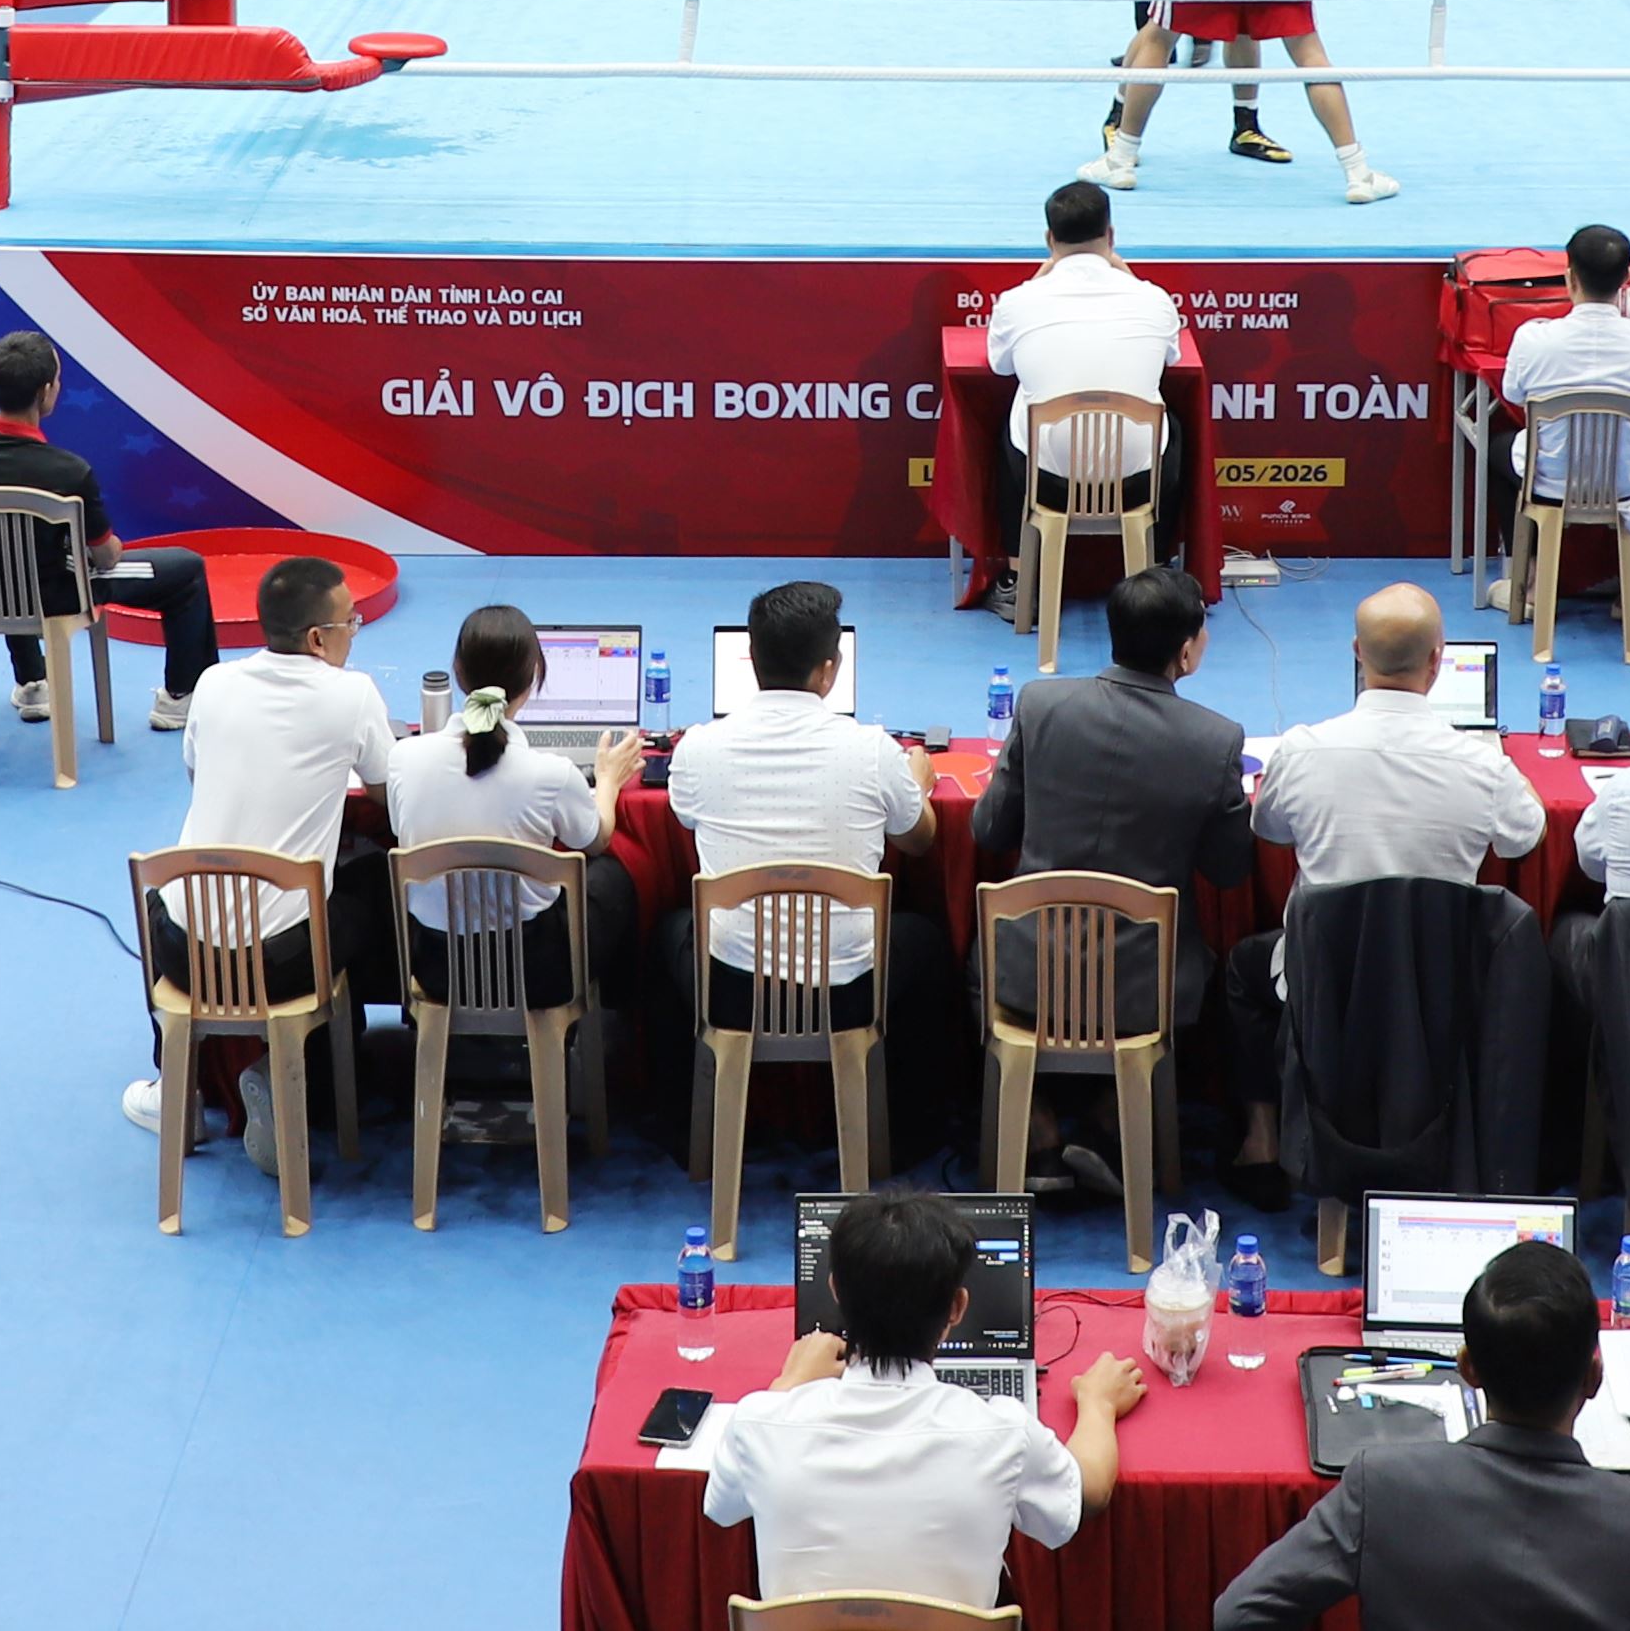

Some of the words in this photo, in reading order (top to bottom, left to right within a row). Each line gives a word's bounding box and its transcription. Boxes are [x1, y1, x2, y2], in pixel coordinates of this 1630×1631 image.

[252, 280, 279, 302] ỦY
[284, 285, 326, 302] BAN
[331, 284, 385, 304] NHÂN
[390, 284, 432, 305] DÂN
[438, 283, 481, 305] TỈNH
[486, 285, 526, 306] LÀO
[531, 289, 563, 306] CAI
[957, 290, 984, 311] BỘ
[1190, 291, 1219, 309] VÀ
[1225, 293, 1253, 309] DU
[1259, 293, 1299, 312] LỊCH
[241, 305, 268, 323] SỞ
[274, 304, 316, 323] VĂN
[373, 303, 409, 325] THỂ
[414, 309, 468, 326] THAO
[472, 306, 504, 326] VÀ
[508, 310, 537, 326] DU
[543, 310, 582, 330] LỊCH
[1196, 312, 1235, 332] VIỆT
[1240, 314, 1290, 330] NAM
[381, 368, 474, 417] GIẢI
[493, 372, 565, 418] VÔ
[583, 381, 694, 426] ĐỊCH
[713, 382, 891, 420] BOXING
[1211, 383, 1276, 420] NH
[1296, 376, 1429, 421] TOÀN
